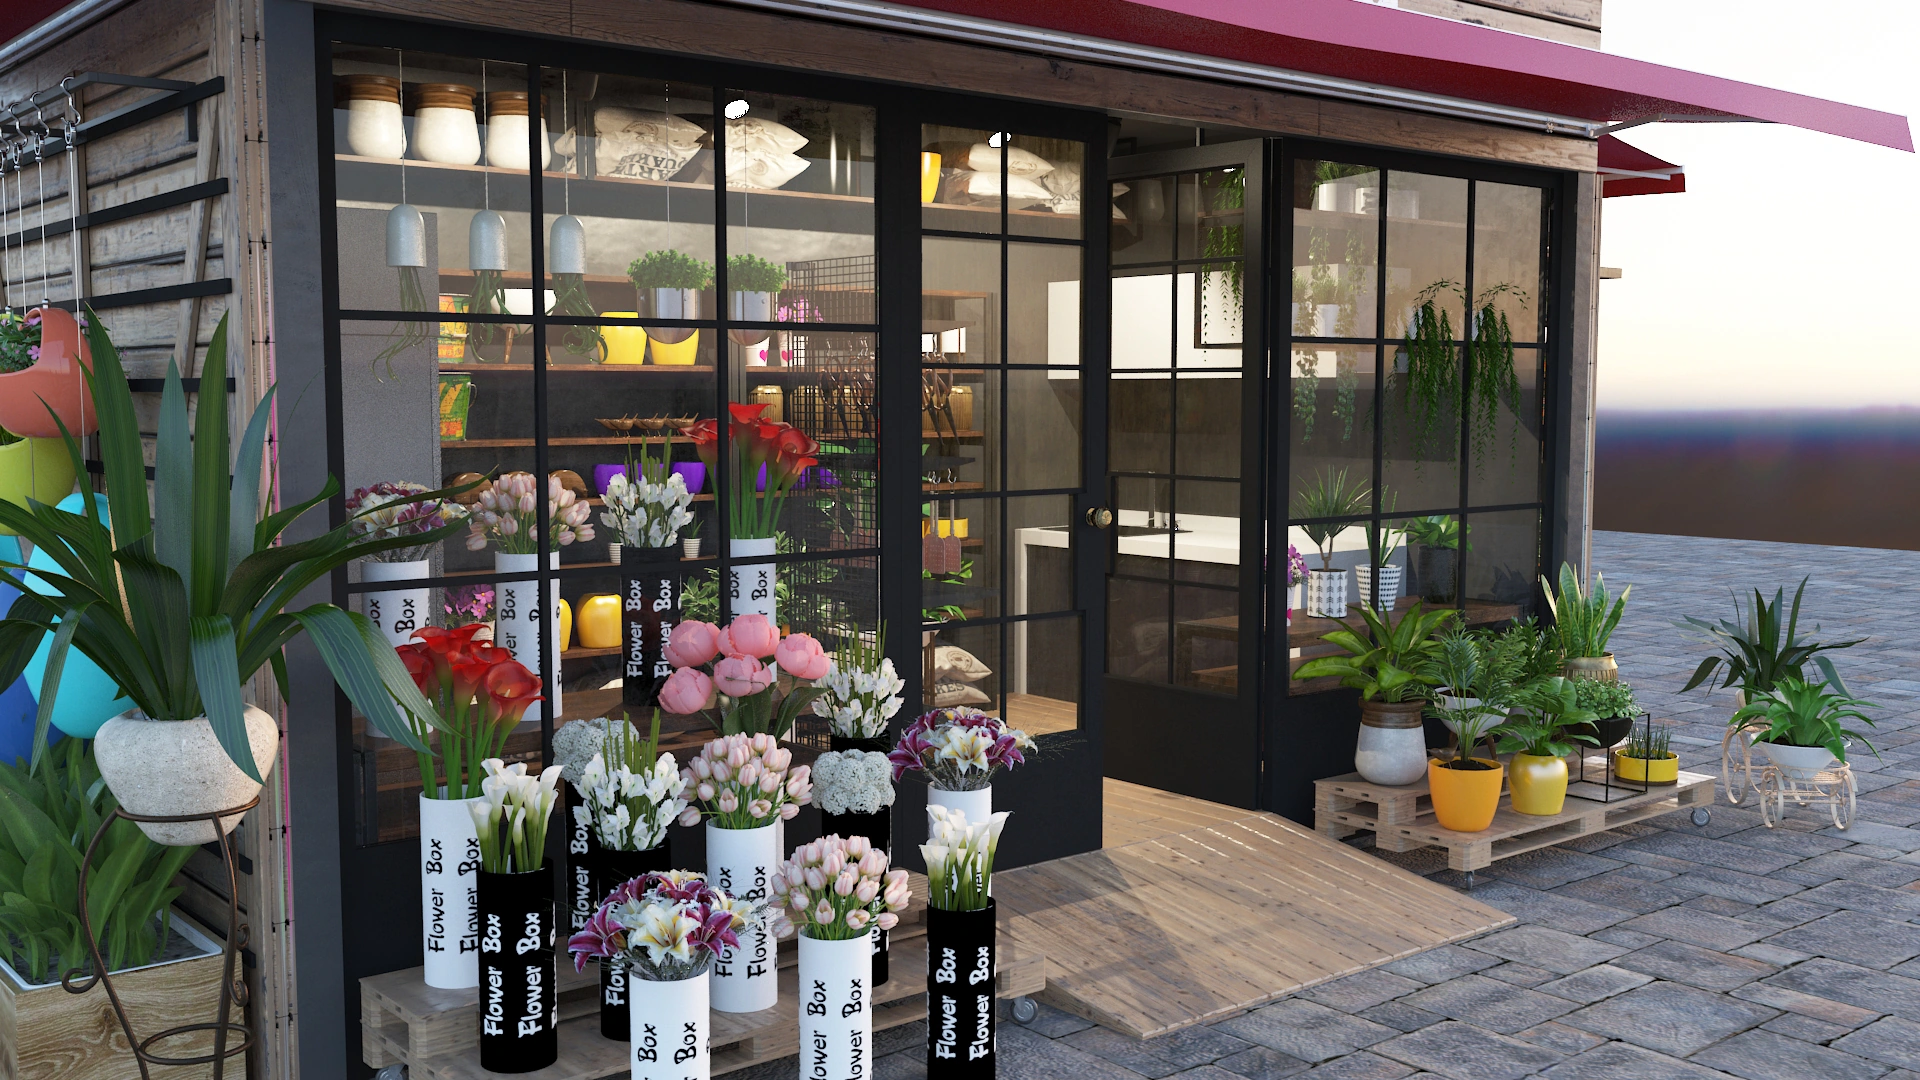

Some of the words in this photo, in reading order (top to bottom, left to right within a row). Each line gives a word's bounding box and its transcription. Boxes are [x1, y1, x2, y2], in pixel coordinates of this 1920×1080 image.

[500, 588, 516, 621] Box
[625, 580, 642, 612] Box
[652, 579, 672, 613] Box
[751, 570, 768, 601] Box
[394, 598, 415, 634] Box
[626, 621, 643, 677] Flower
[425, 838, 443, 875] Box
[457, 837, 480, 877] Box
[571, 866, 590, 929] Flower
[746, 865, 766, 902] Box
[427, 887, 445, 953] Flower
[481, 913, 502, 953] Box
[515, 912, 541, 956] Box
[935, 946, 957, 984] Box
[968, 946, 990, 986] Box
[483, 965, 504, 1036] Flower
[517, 965, 543, 1038] Flower
[806, 979, 827, 1017] Box
[841, 978, 862, 1018] Box
[637, 1022, 658, 1064] Box
[673, 1021, 697, 1065] Box
[935, 994, 958, 1060] Flower
[968, 994, 990, 1062] Flower
[809, 1029, 828, 1080] lower
[845, 1029, 863, 1080] lower
